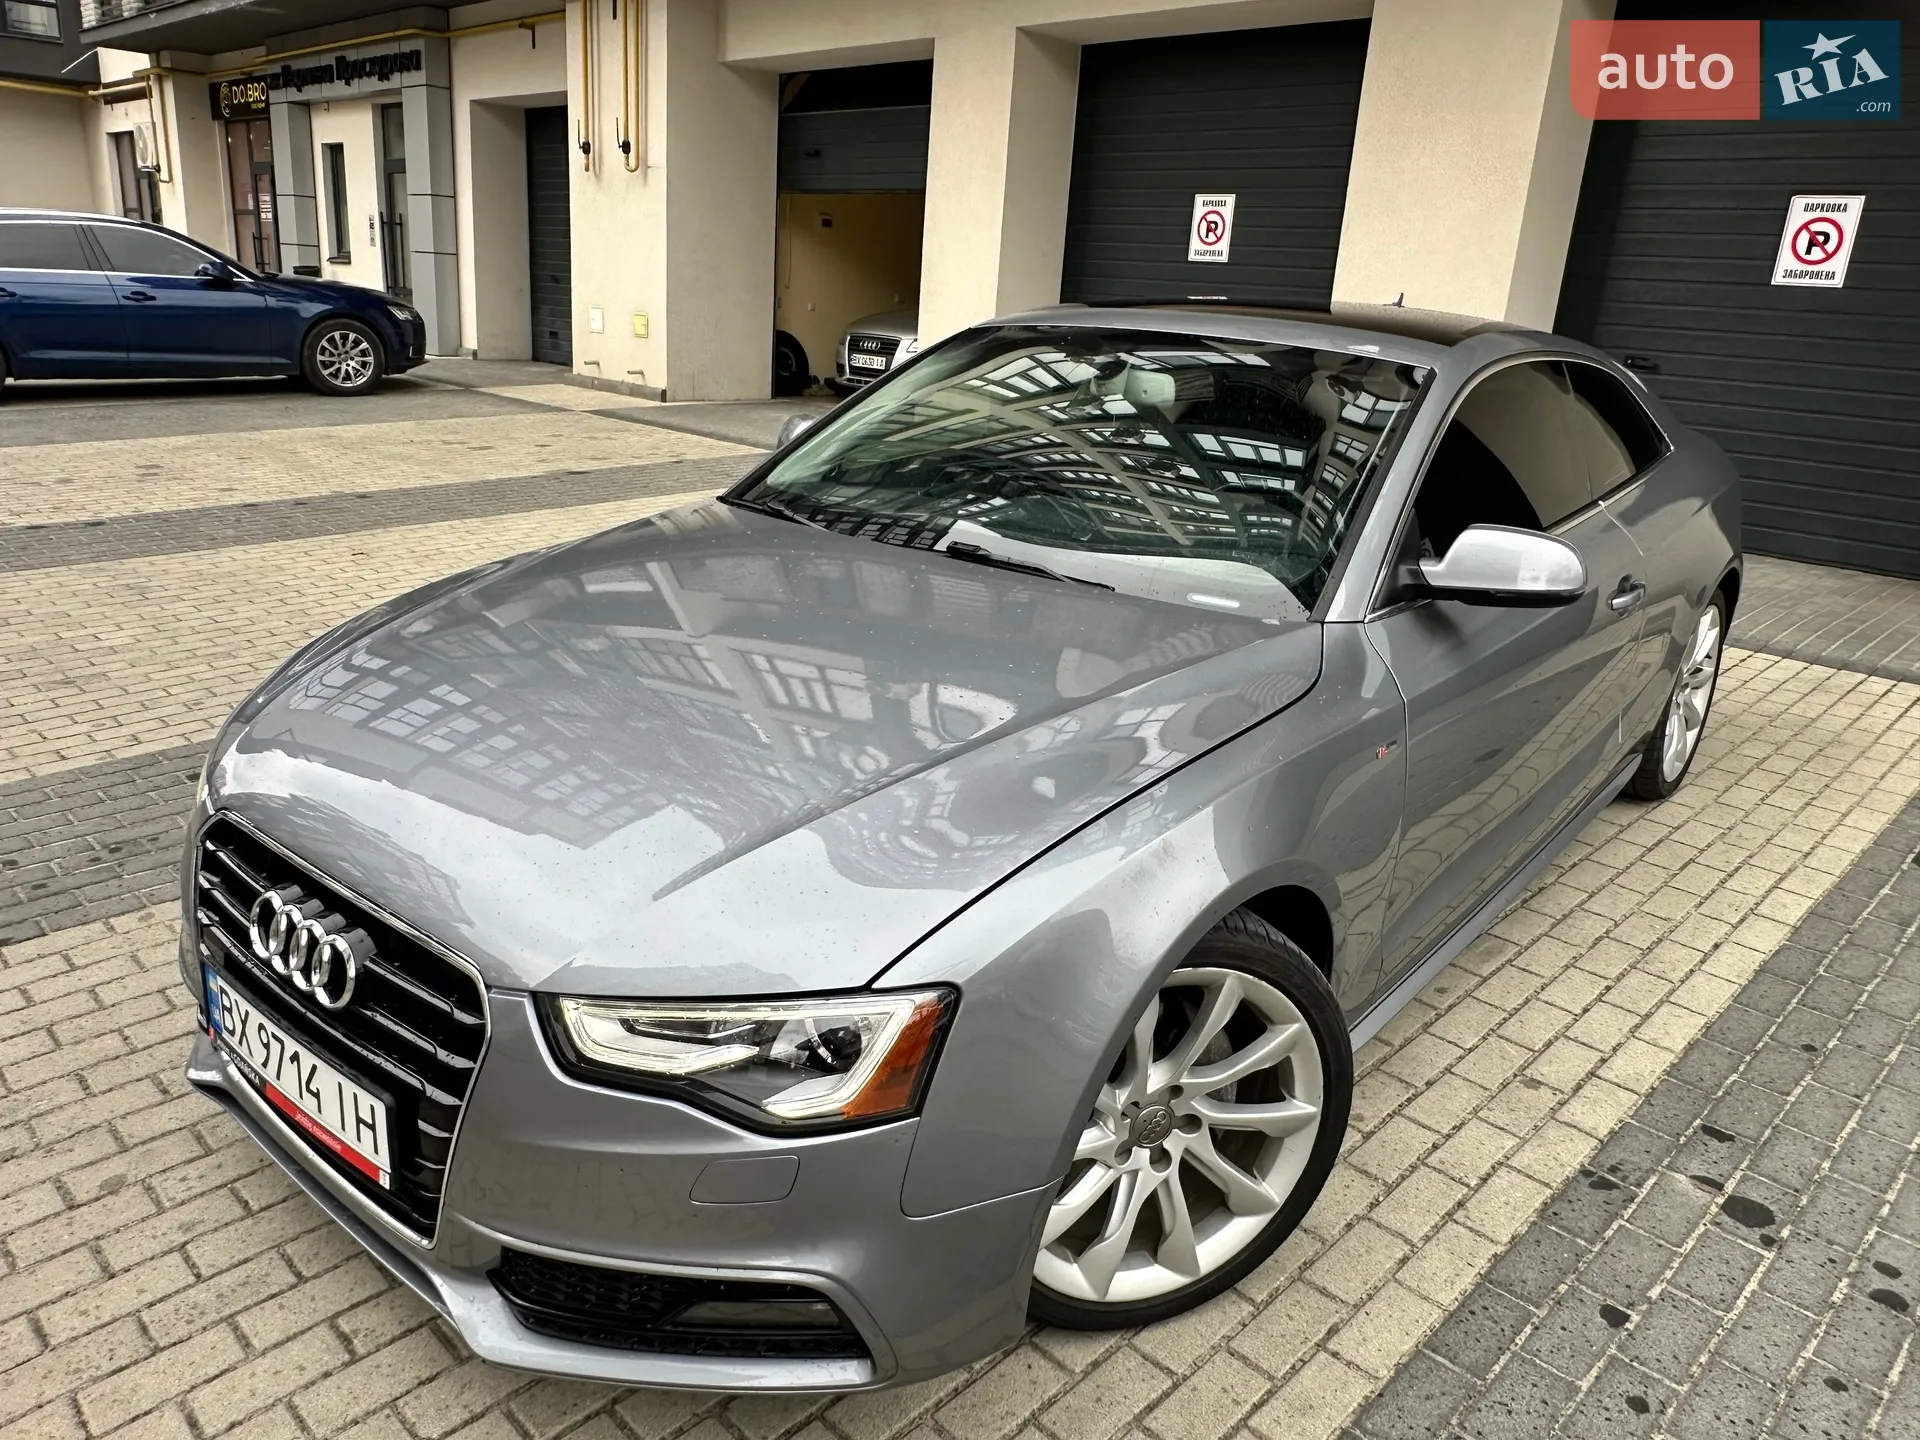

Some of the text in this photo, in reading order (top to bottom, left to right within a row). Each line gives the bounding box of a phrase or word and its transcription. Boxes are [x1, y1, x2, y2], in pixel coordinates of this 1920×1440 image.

[231, 81, 267, 104] DO.BRO
[1803, 202, 1848, 213] ПАРКОВКА
[1804, 230, 1831, 256] P
[1782, 269, 1836, 281] ЗАБОРОНЕНА
[219, 984, 253, 1057] BX
[257, 1021, 323, 1115] 9714
[338, 1081, 379, 1156] IH
